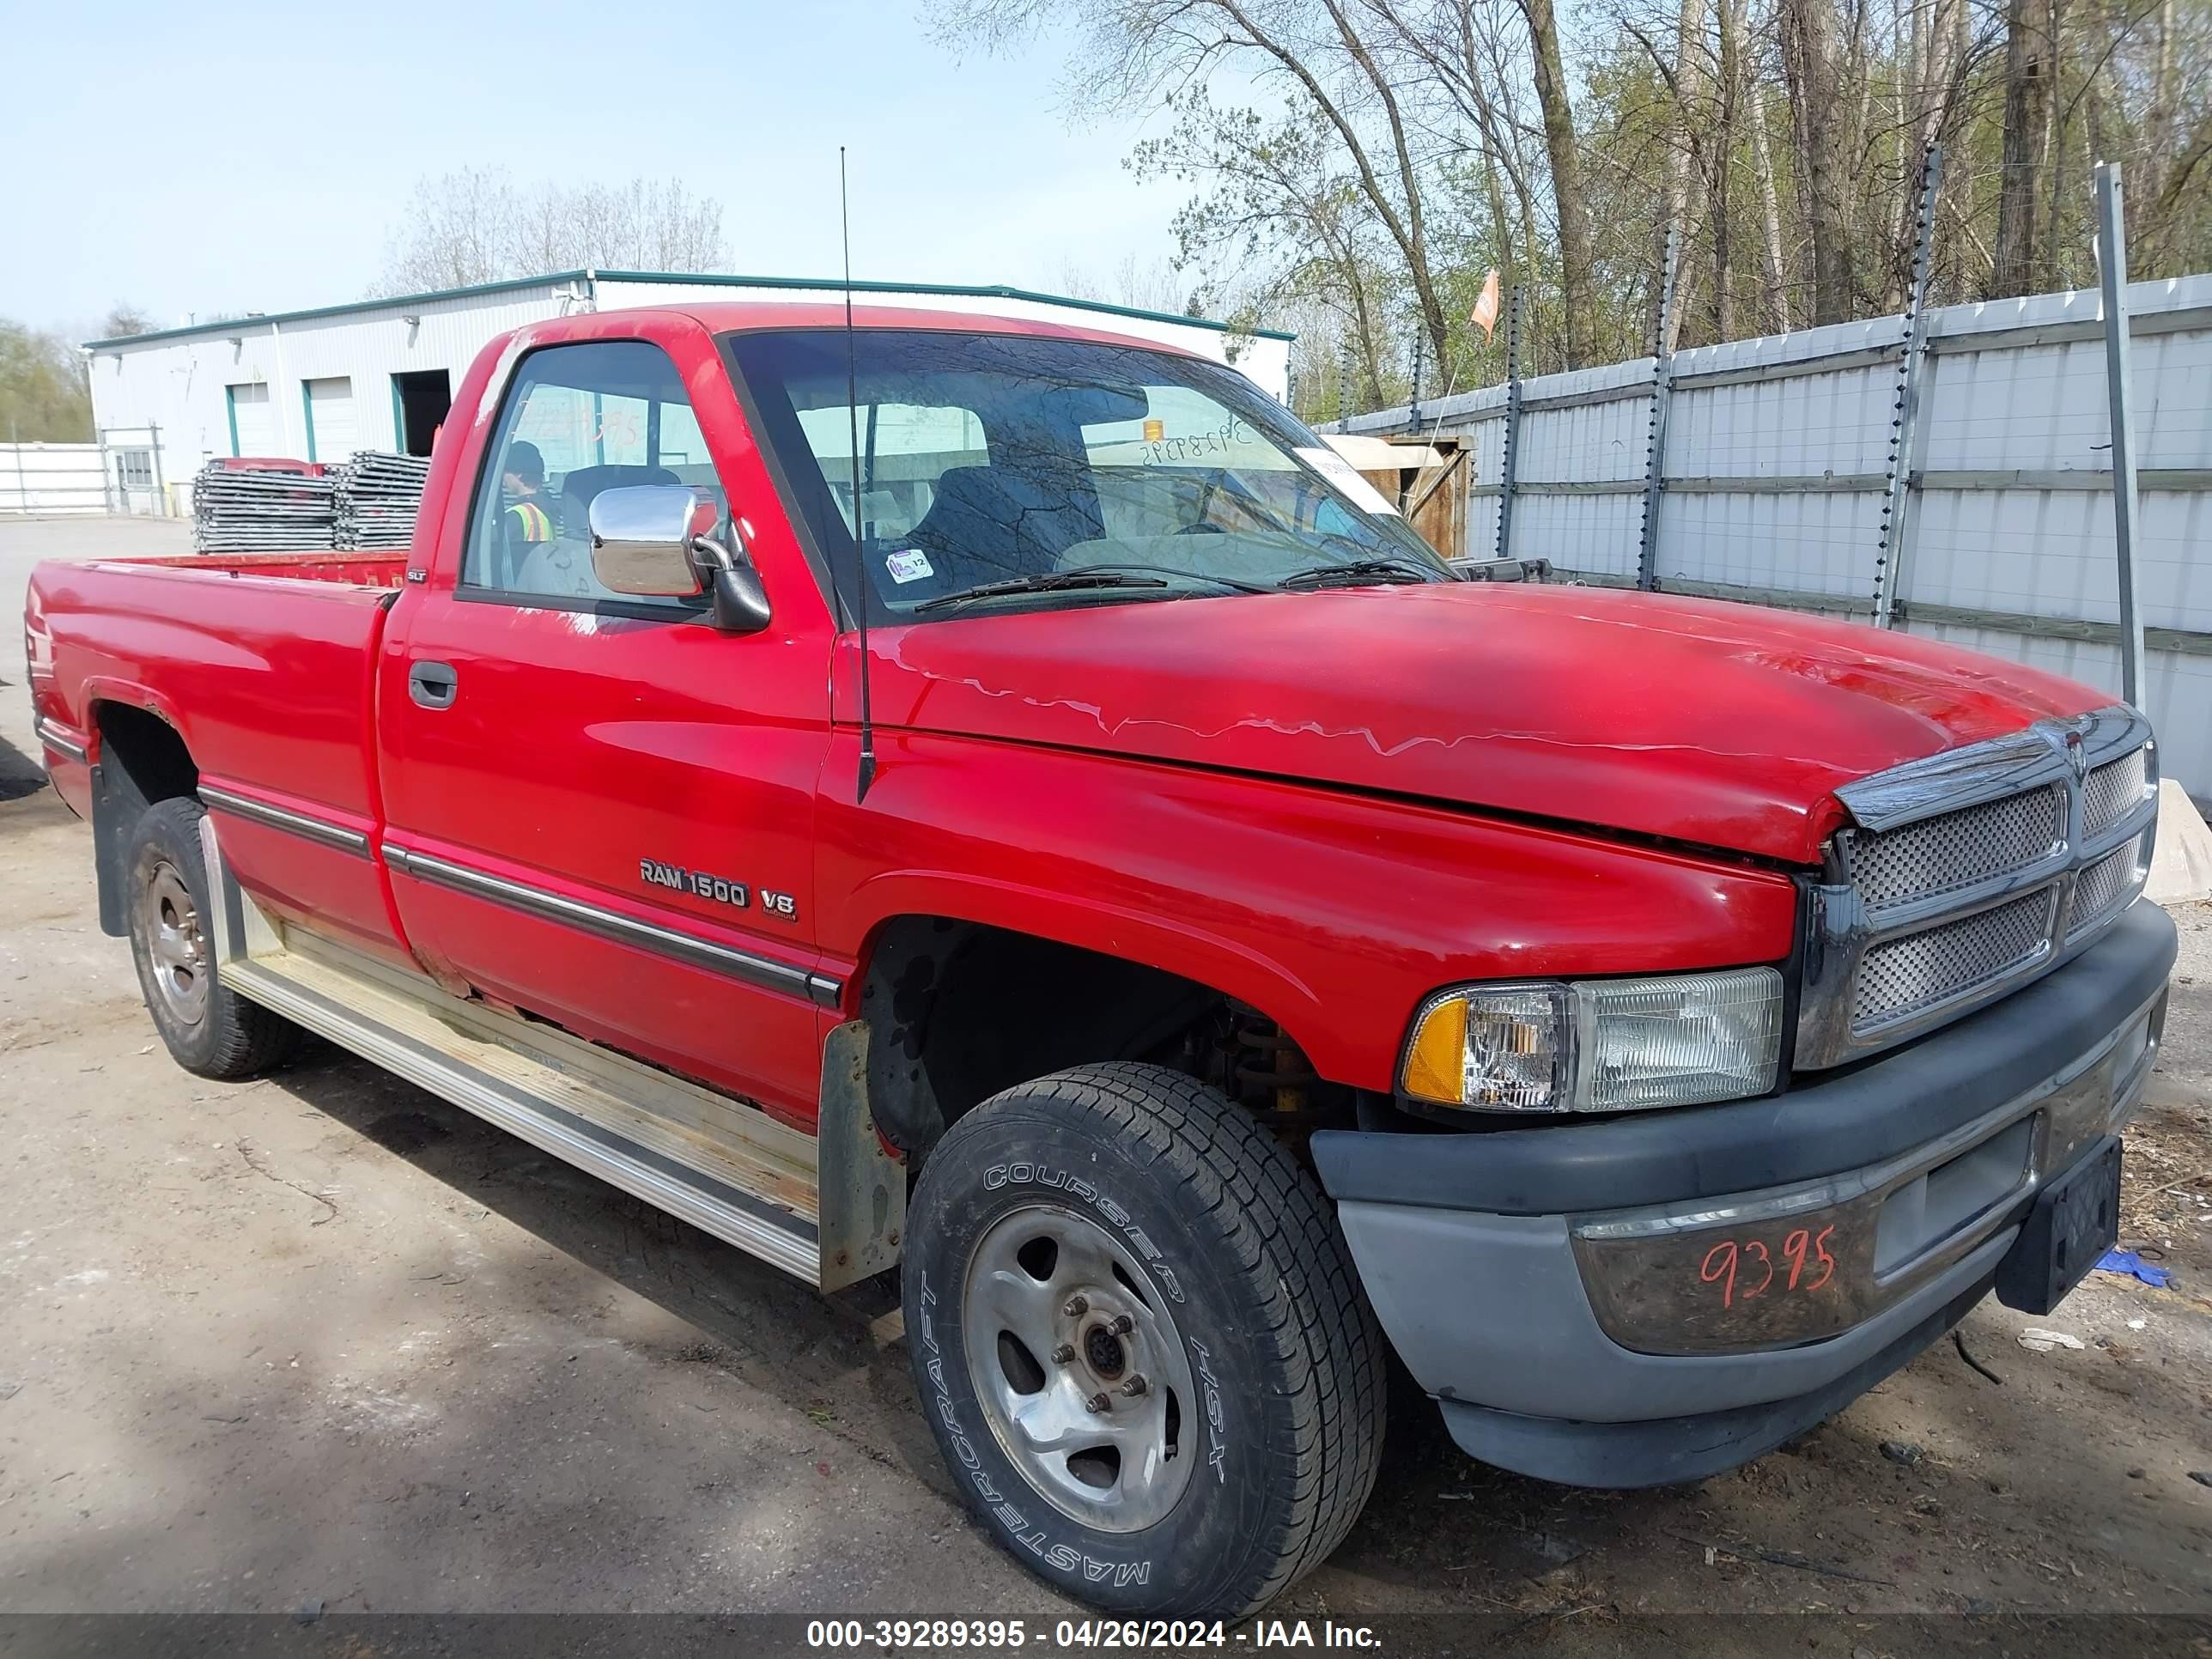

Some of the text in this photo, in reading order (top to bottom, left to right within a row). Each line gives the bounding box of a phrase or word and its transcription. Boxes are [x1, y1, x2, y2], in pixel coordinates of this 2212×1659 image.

[408, 571, 427, 581] SLT
[913, 558, 926, 567] 12
[640, 860, 745, 908] RAM 1500
[761, 890, 794, 914] V8
[982, 1162, 1187, 1304] COURSER
[1700, 1224, 1835, 1309] 9395
[919, 1270, 1152, 1589] MASTERCRAFT
[1189, 1335, 1225, 1485] HSX
